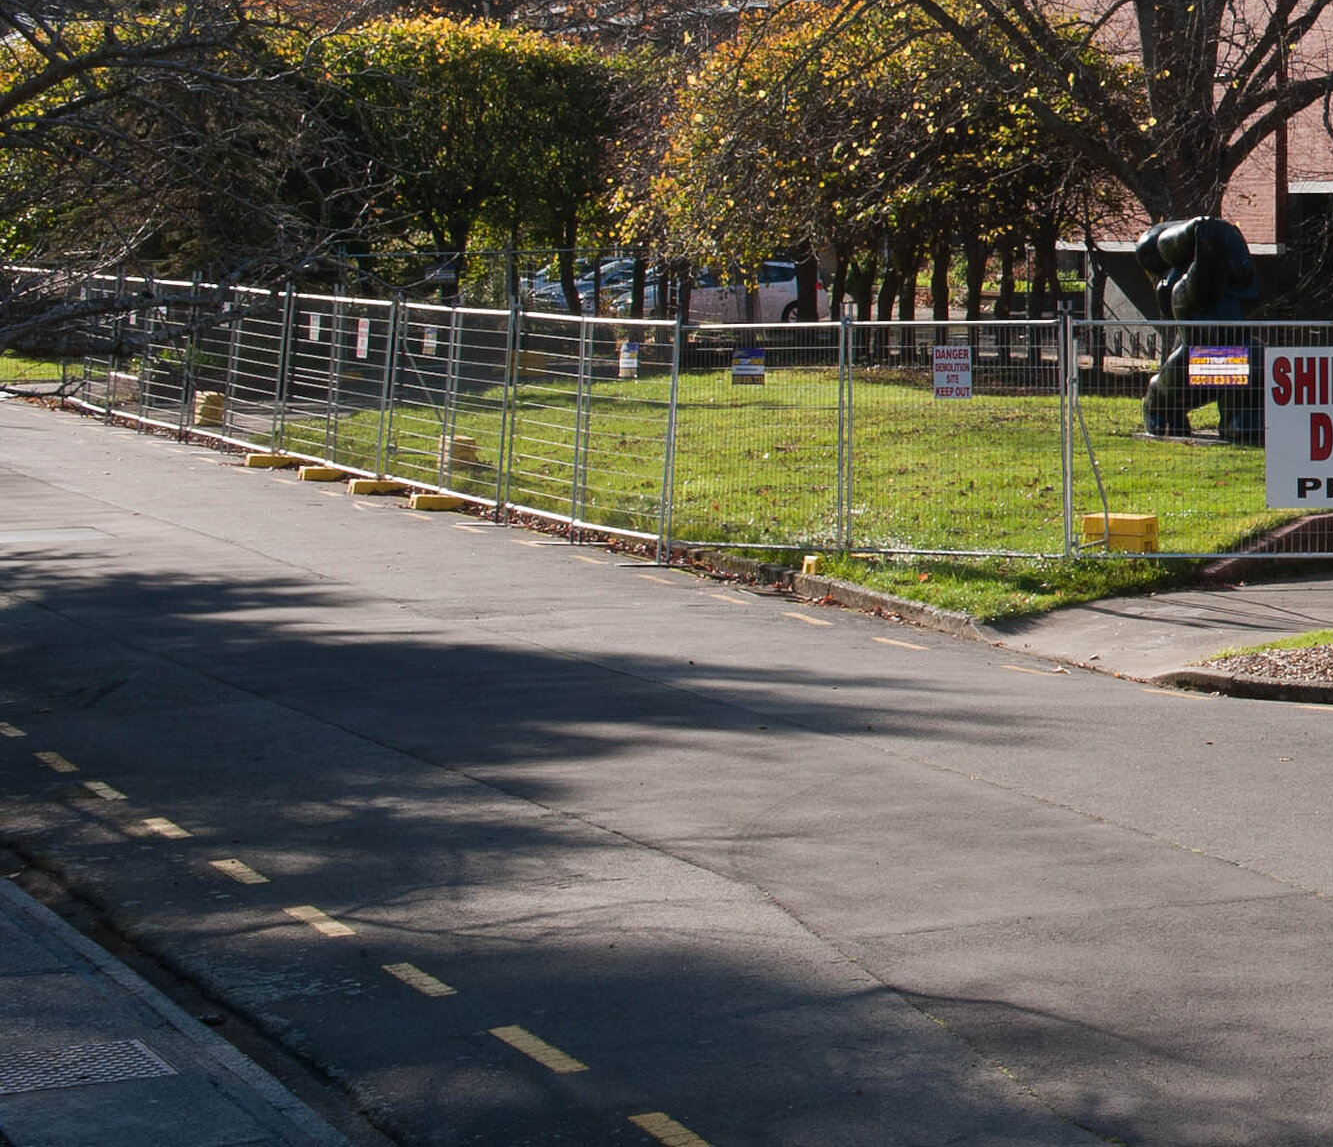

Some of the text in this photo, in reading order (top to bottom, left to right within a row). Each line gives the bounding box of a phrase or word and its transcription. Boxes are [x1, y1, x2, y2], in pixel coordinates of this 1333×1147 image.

[935, 349, 969, 360] DANGER
[935, 363, 971, 372] DEMOLITION
[946, 374, 960, 384] SITE
[936, 387, 970, 397] KEEP OUT
